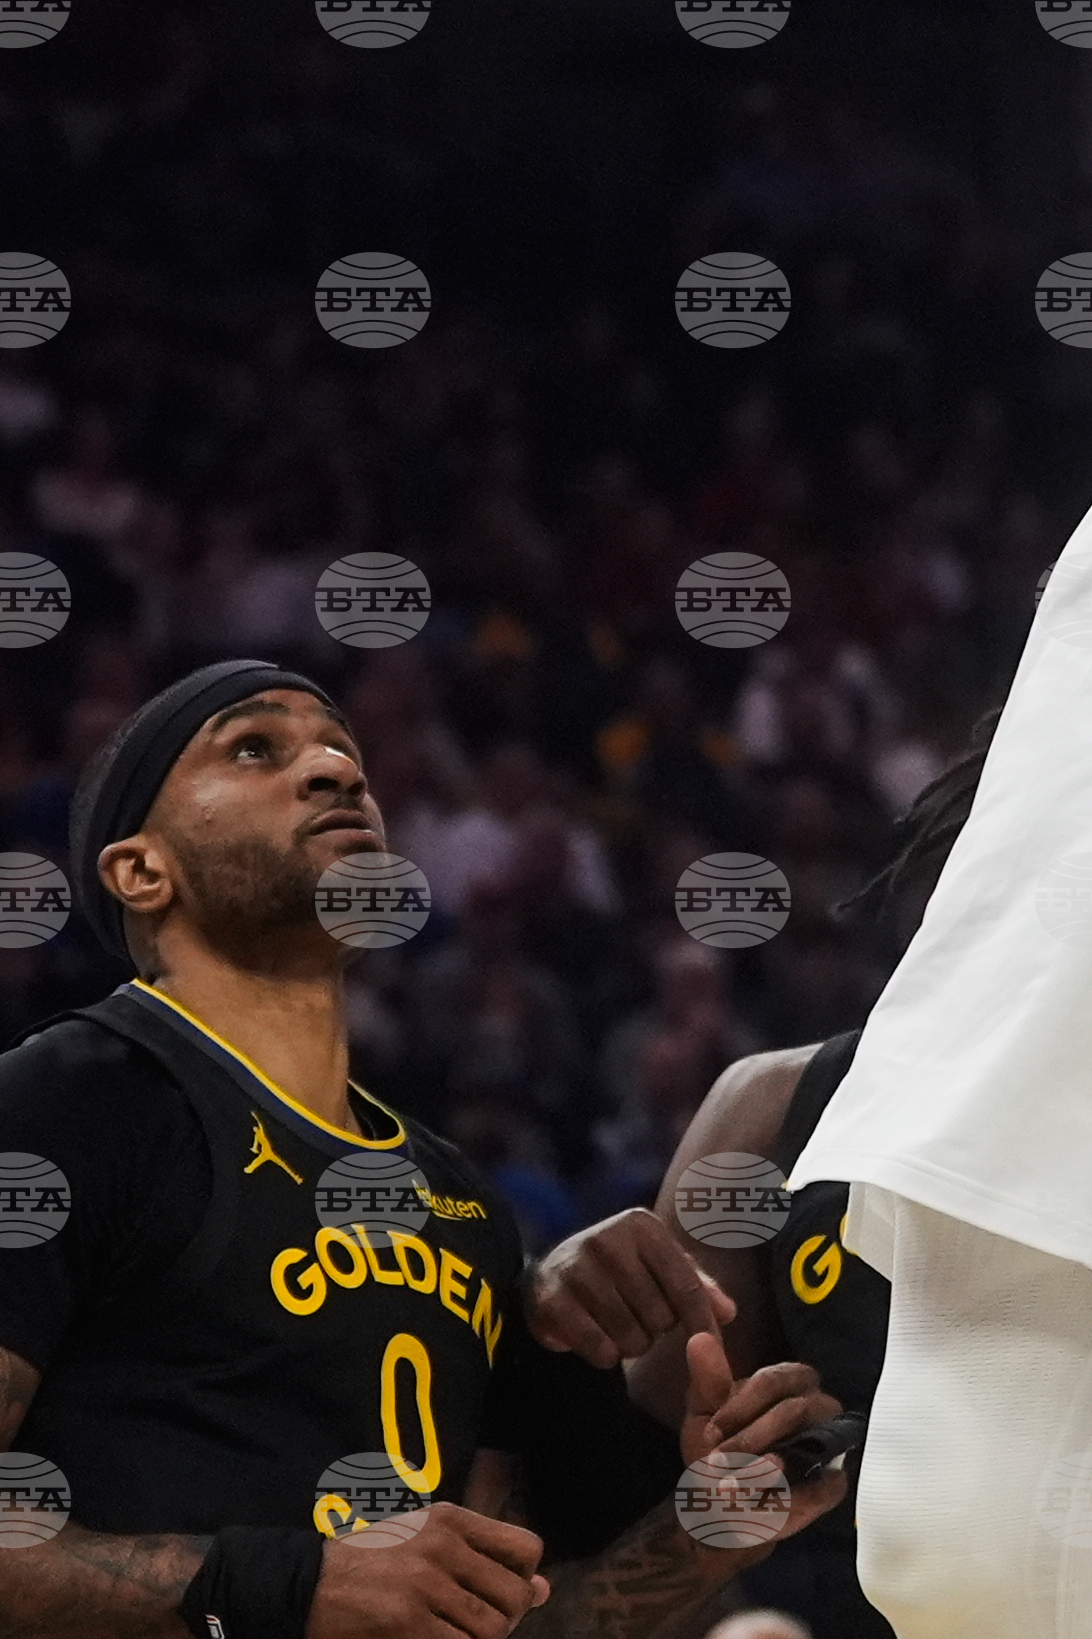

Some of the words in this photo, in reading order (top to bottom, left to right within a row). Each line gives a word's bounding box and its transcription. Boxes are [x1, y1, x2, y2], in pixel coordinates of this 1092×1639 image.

[270, 1223, 503, 1371] GOLDEN
[790, 1216, 850, 1305] G
[381, 1332, 442, 1494] 0
